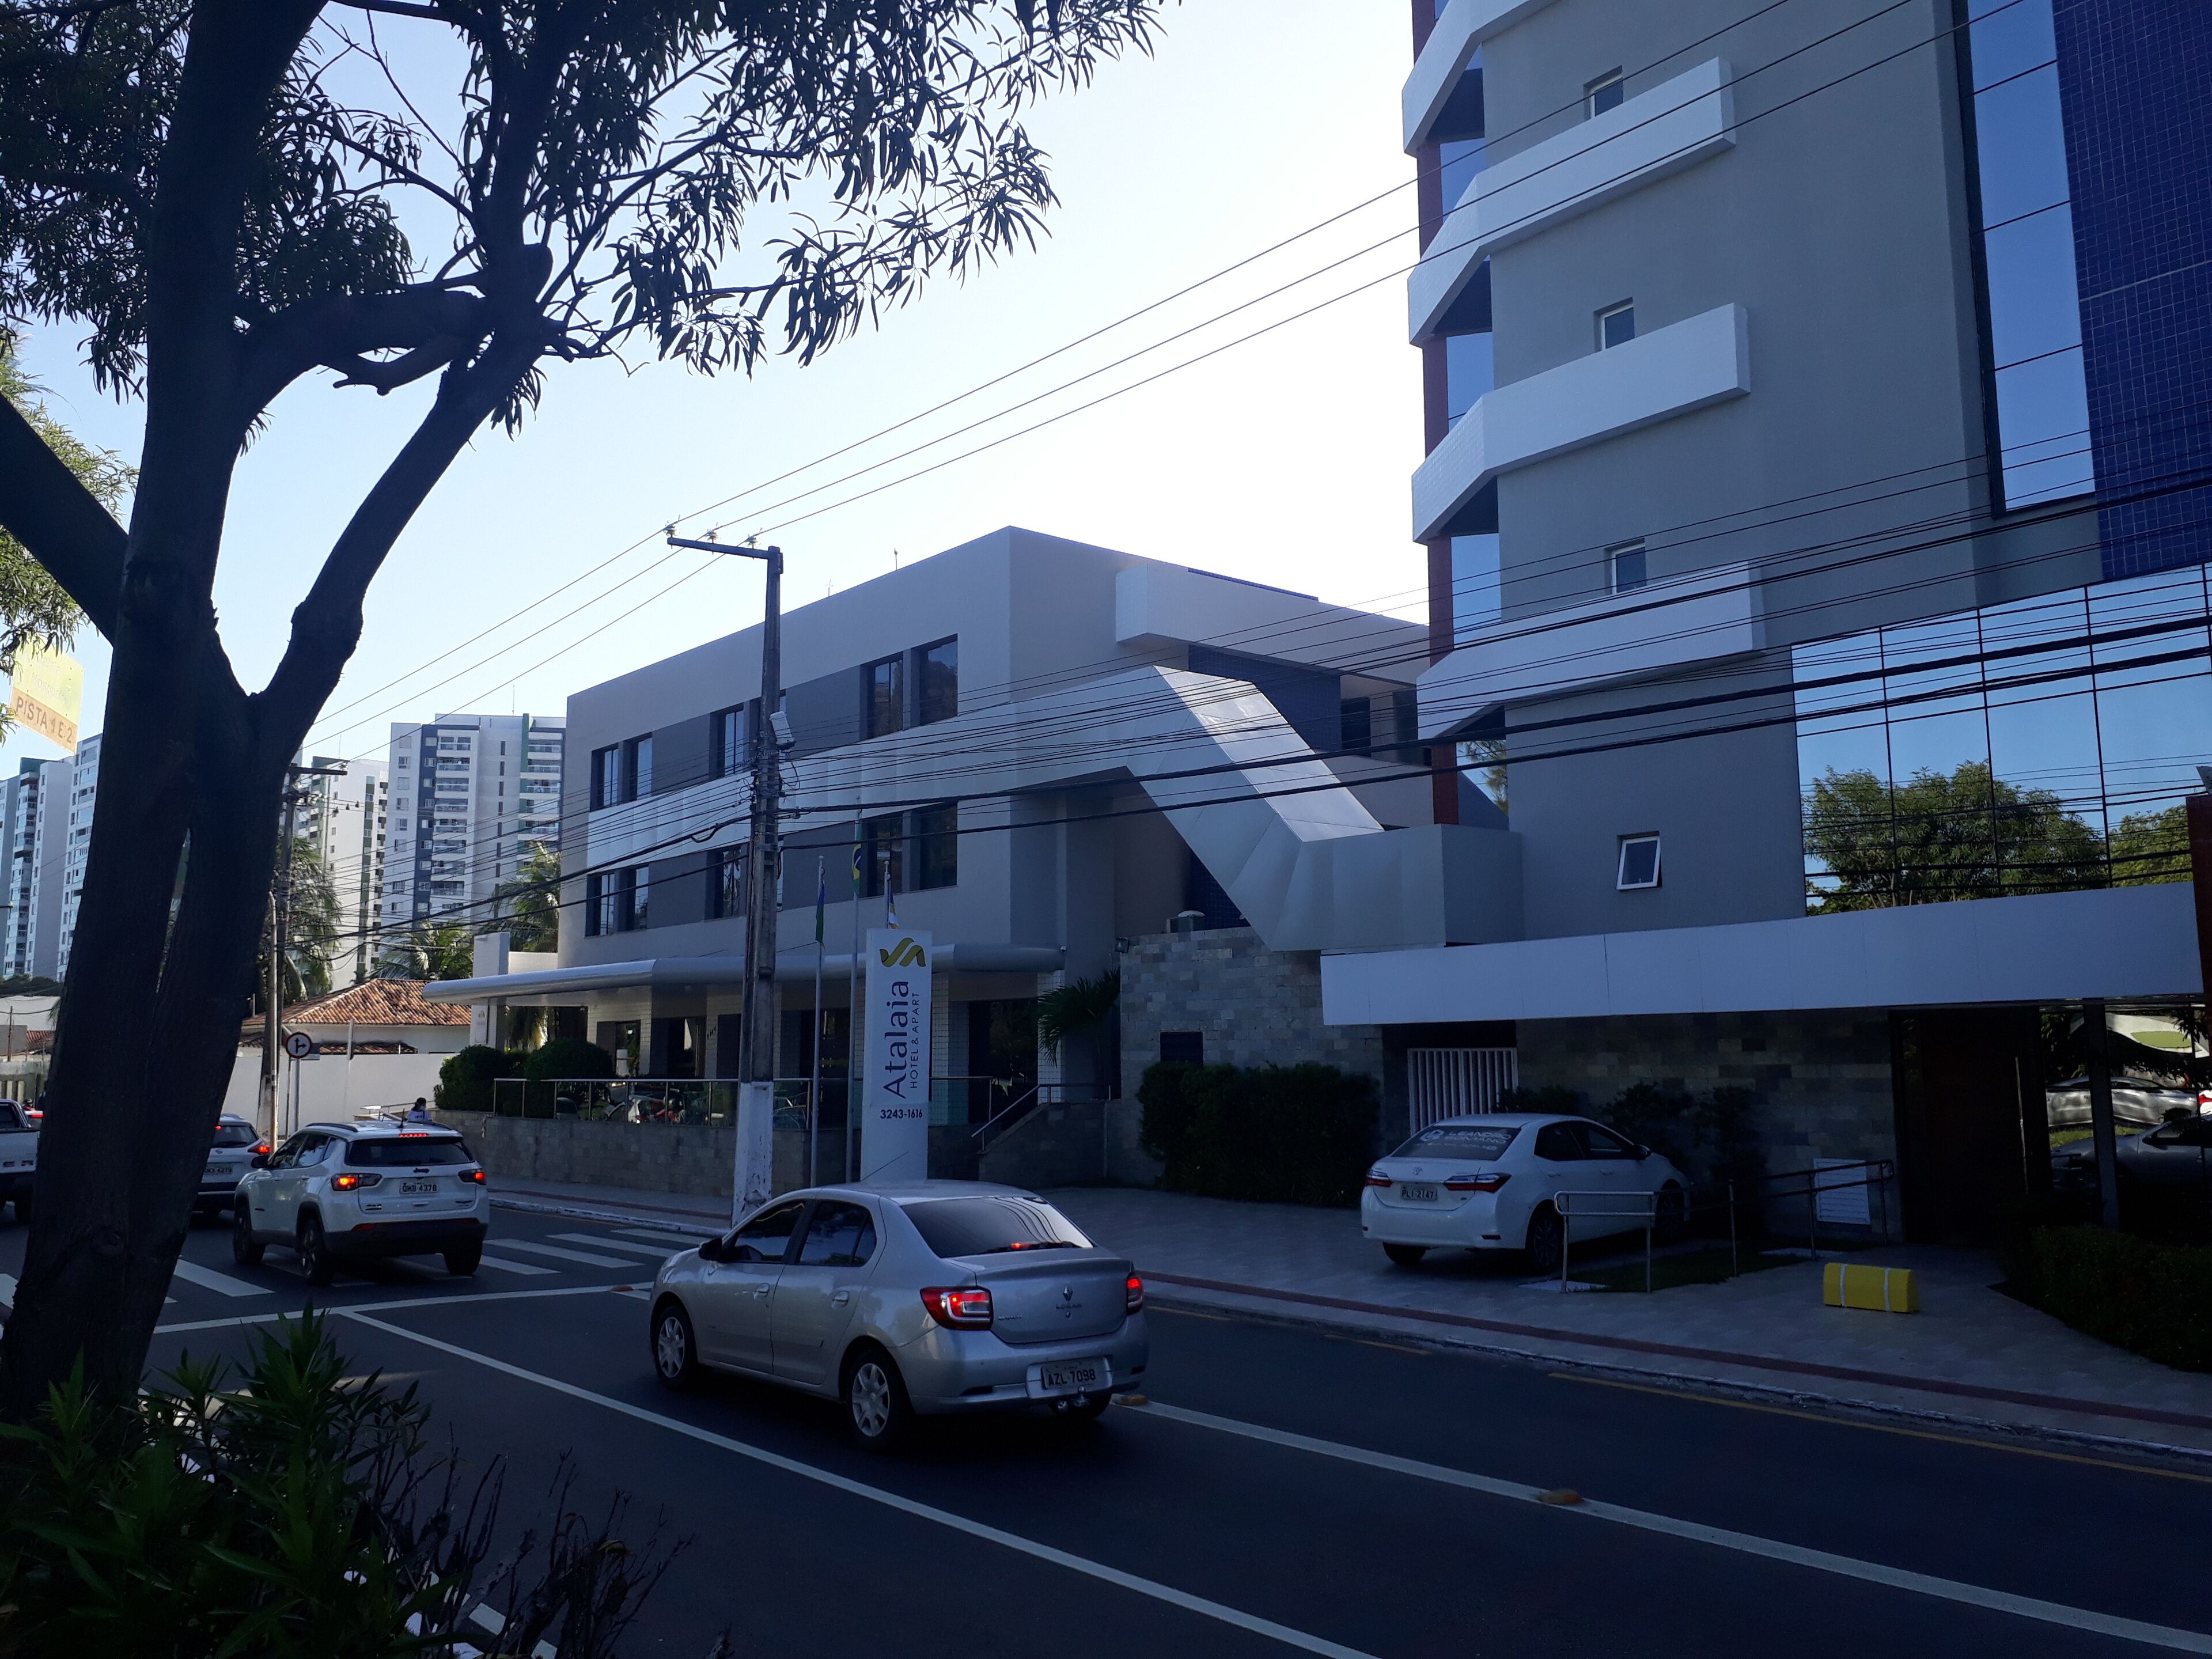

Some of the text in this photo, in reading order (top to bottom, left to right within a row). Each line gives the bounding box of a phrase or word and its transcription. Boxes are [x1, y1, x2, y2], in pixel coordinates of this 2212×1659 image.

[16, 696, 48, 730] PISTA
[67, 726, 73, 744] 2
[883, 981, 910, 1099] Atalaia
[910, 992, 921, 1089] HOTEL & APART
[880, 1108, 923, 1119] 3243-1616
